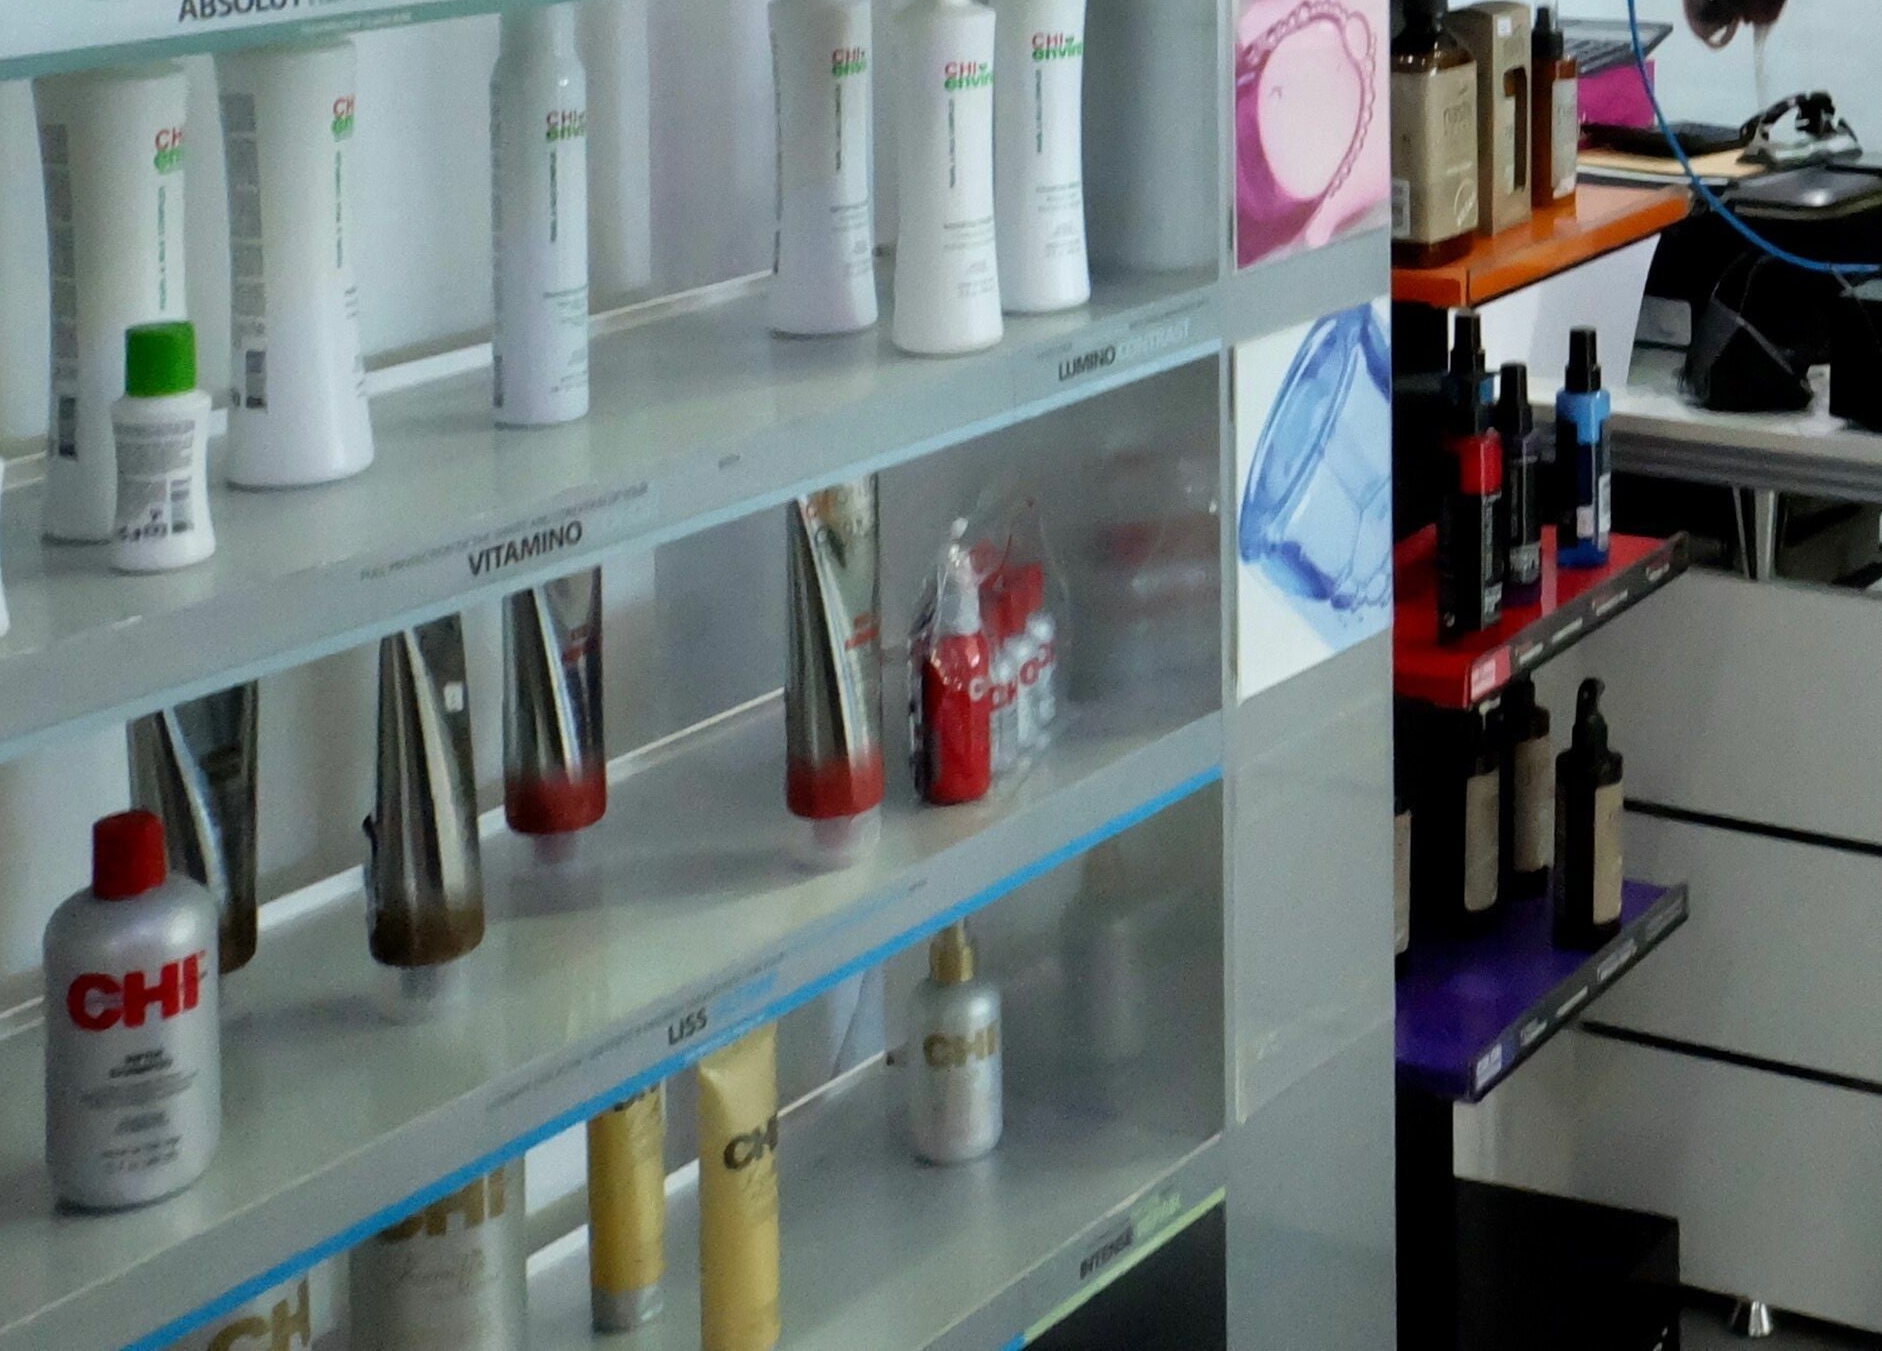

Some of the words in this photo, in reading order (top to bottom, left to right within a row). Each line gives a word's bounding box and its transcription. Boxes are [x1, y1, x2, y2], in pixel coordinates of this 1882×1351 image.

[944, 60, 977, 78] CHI
[1058, 344, 1116, 382] LUMINO
[467, 519, 584, 577] VITAMINO
[66, 953, 202, 1032] CHI
[667, 1007, 708, 1046] LISS
